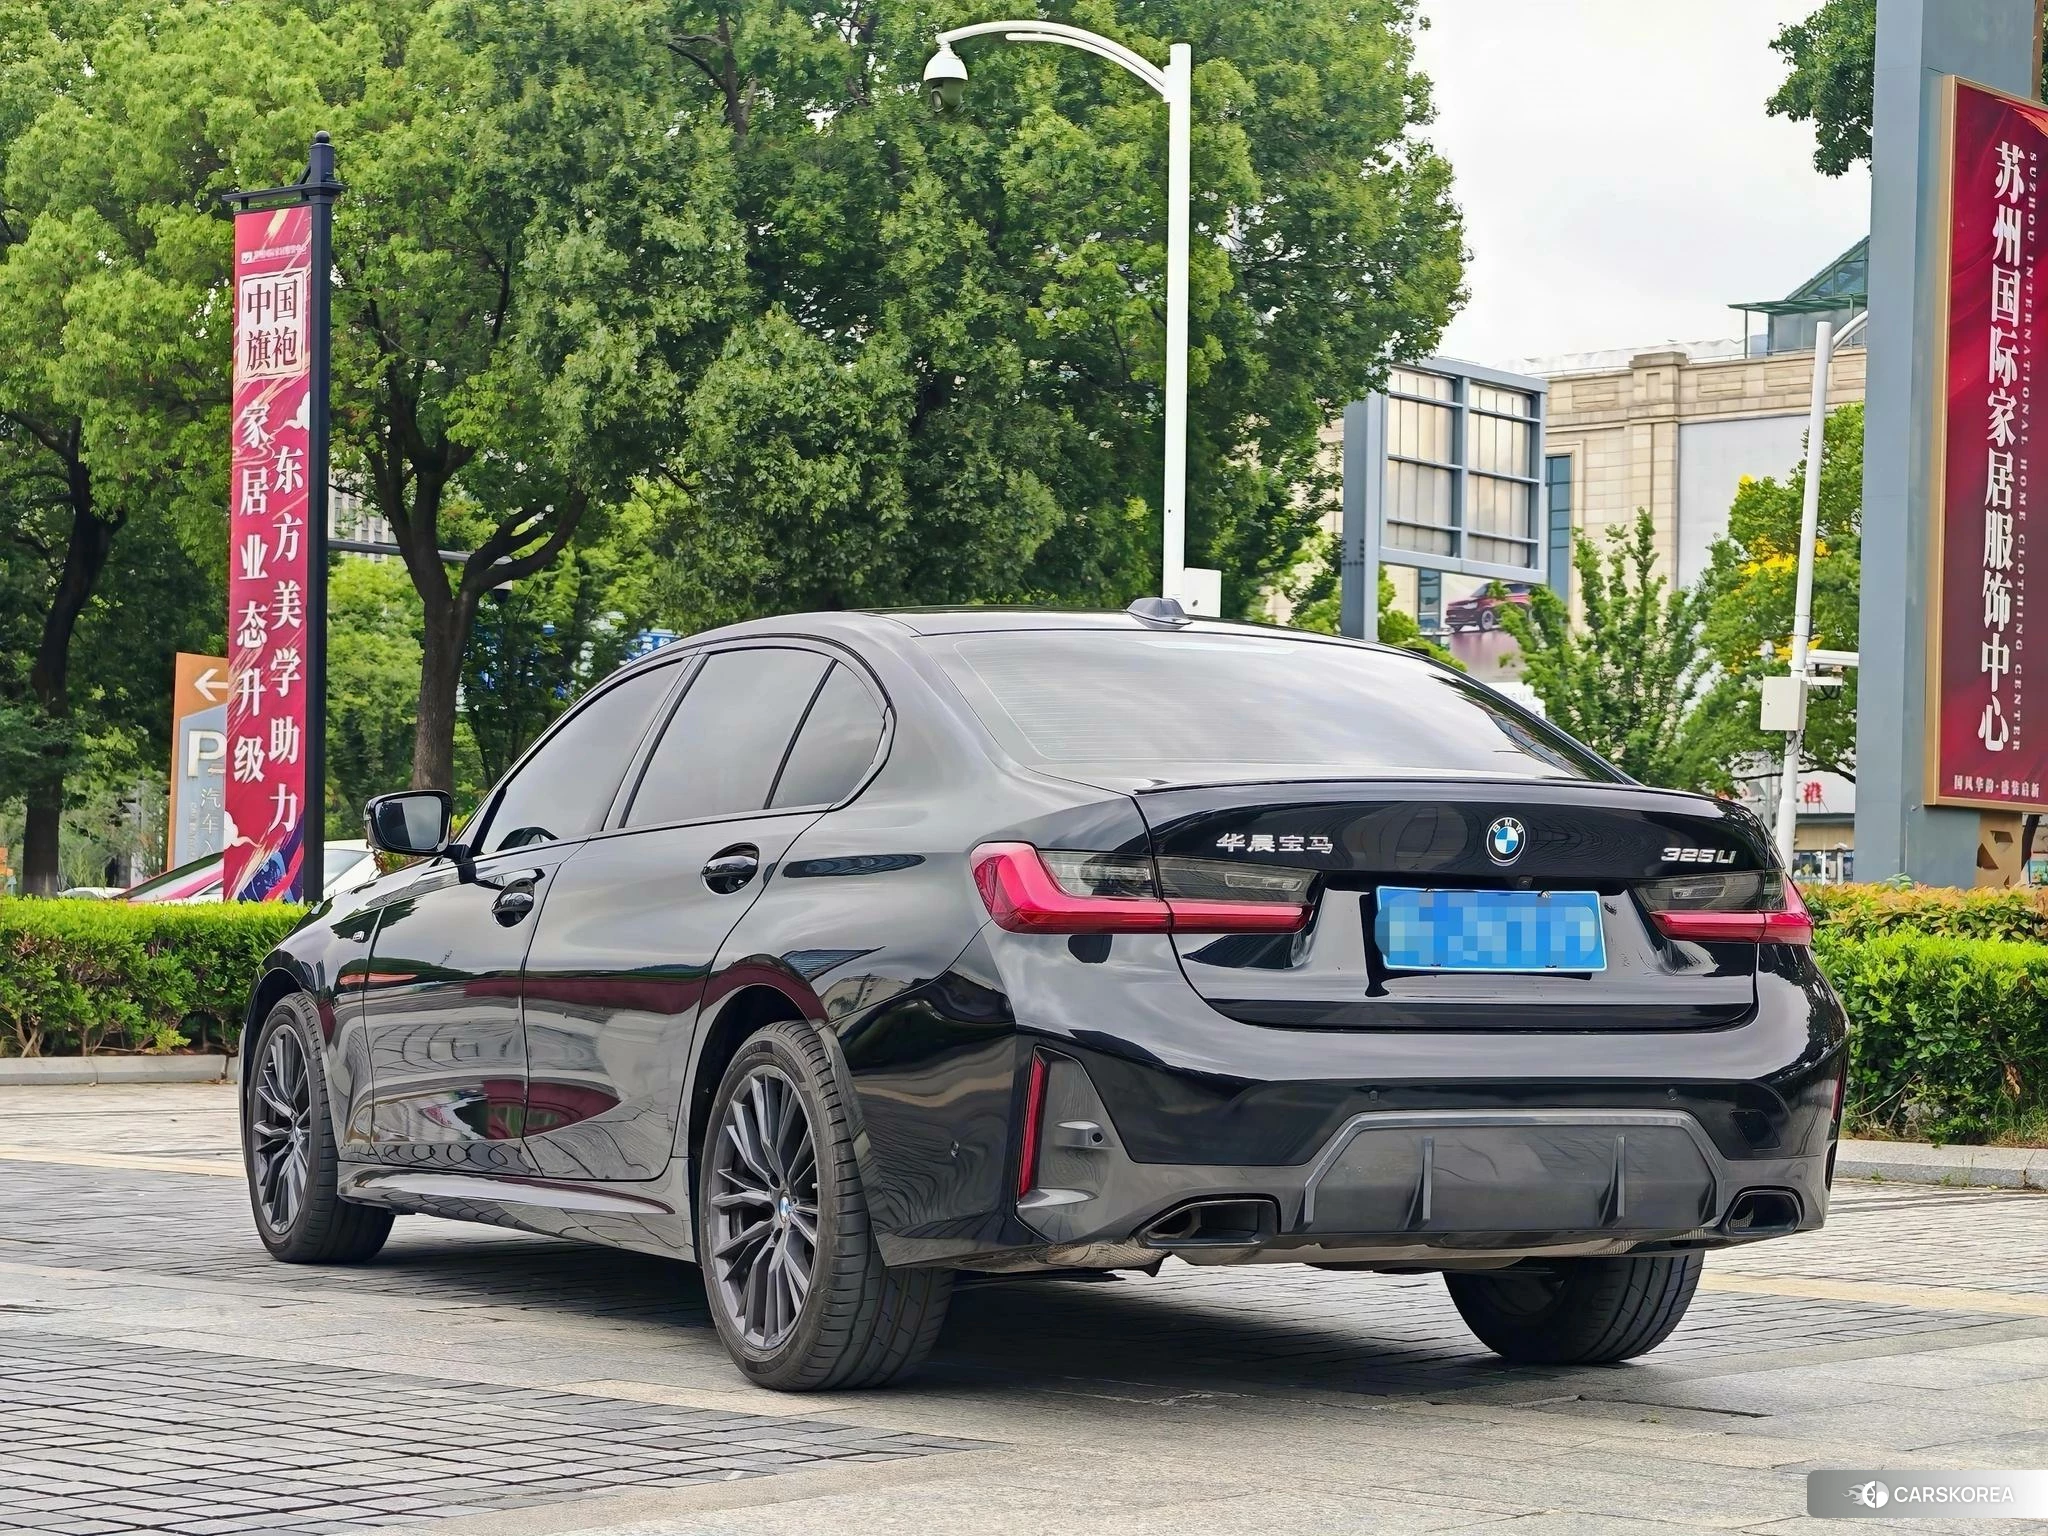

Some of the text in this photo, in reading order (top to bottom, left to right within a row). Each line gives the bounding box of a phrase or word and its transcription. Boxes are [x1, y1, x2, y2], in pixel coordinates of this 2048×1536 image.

[245, 326, 298, 372] 旗袍
[246, 278, 298, 326] 中国
[1977, 140, 2026, 752] 苏州国际家居服饰中心
[2012, 152, 2037, 751] SUZHOU INTERNATIONAL HOME CLOTHING CENTER
[233, 400, 271, 784] 家居业态升级
[268, 445, 304, 835] 东方美学助力
[1215, 833, 1334, 855] 华晨宝马
